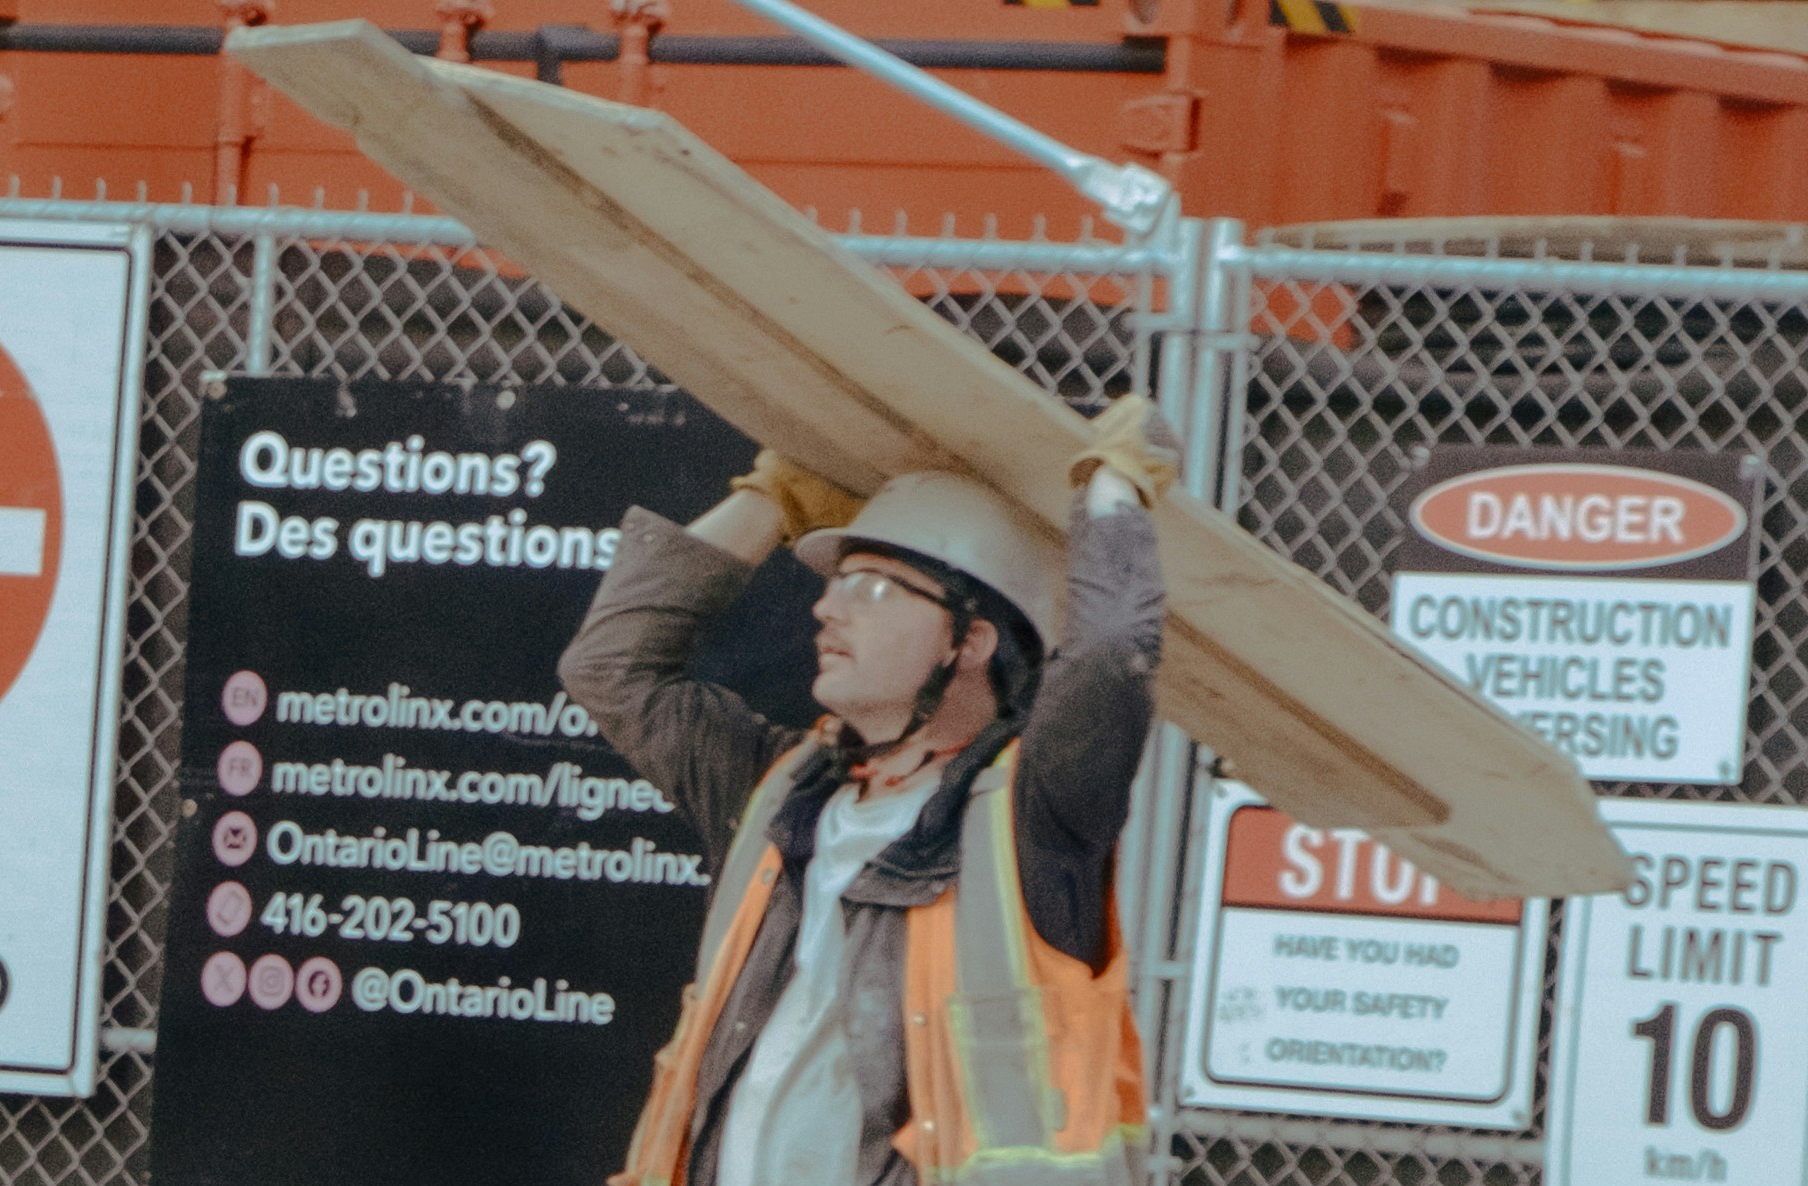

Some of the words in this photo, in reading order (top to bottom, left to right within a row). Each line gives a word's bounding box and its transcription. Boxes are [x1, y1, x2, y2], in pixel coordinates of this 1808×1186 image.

[240, 430, 557, 498] Questions?
[235, 500, 339, 560] Des
[348, 508, 621, 578] questions
[1466, 490, 1687, 544] DANGER
[1410, 594, 1733, 648] CONSTRUCTION
[1466, 652, 1666, 703] VEHICLES
[277, 682, 598, 737] metrolinx.com/o
[1520, 710, 1680, 759] ERSING
[266, 820, 711, 886] OntarioLine@metrolinx.
[1278, 822, 1439, 906] STO
[1623, 854, 1798, 917] SPEED
[260, 892, 521, 948] 416-202-5100
[1274, 933, 1339, 960] HAVE
[1345, 938, 1400, 964] YOU
[1404, 943, 1460, 968] HAD
[1626, 922, 1783, 987] LIMIT
[351, 966, 615, 1025] @OntarioLine
[1274, 986, 1347, 1012] YOUR
[1351, 991, 1449, 1019] SAFETY
[1265, 1037, 1447, 1072] ORIENTATION?
[1631, 1001, 1760, 1134] 10
[1643, 1146, 1729, 1183] km/h
